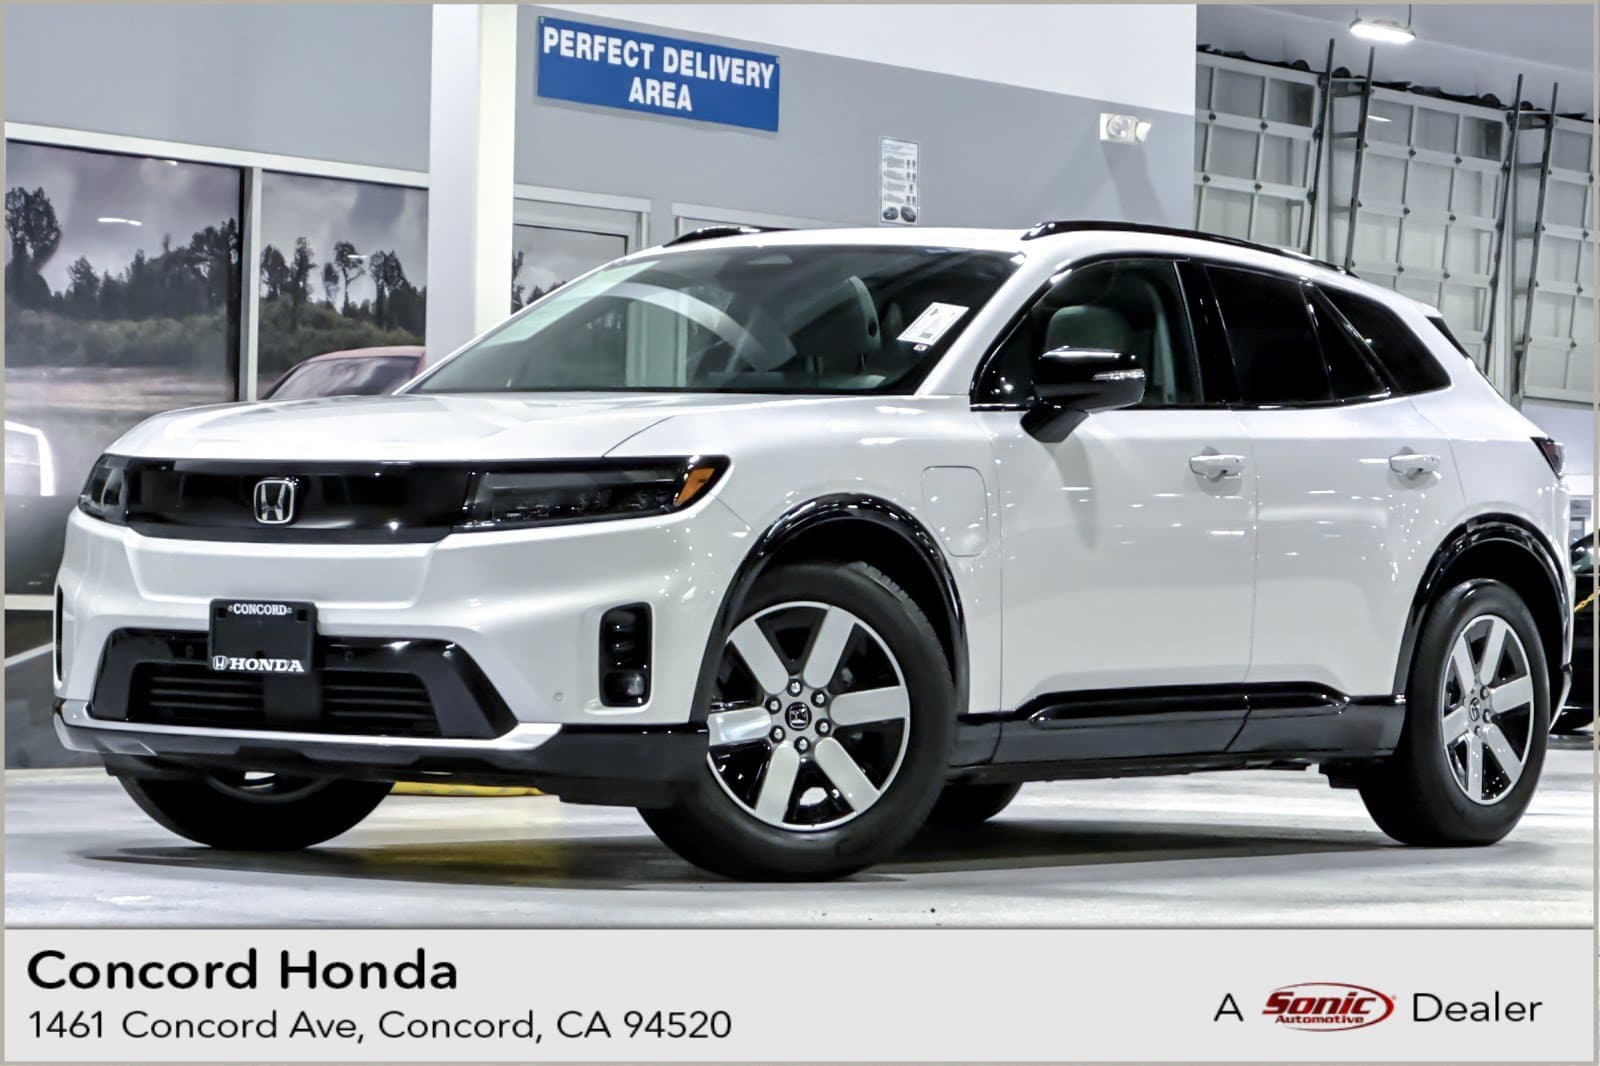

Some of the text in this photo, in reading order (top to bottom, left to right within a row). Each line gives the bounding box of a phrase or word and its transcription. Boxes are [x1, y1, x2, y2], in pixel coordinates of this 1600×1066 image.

[543, 26, 774, 89] PERFECT DELIVERY
[628, 76, 693, 112] AREA
[233, 603, 287, 615] CONCORD
[229, 657, 304, 672] HONDA
